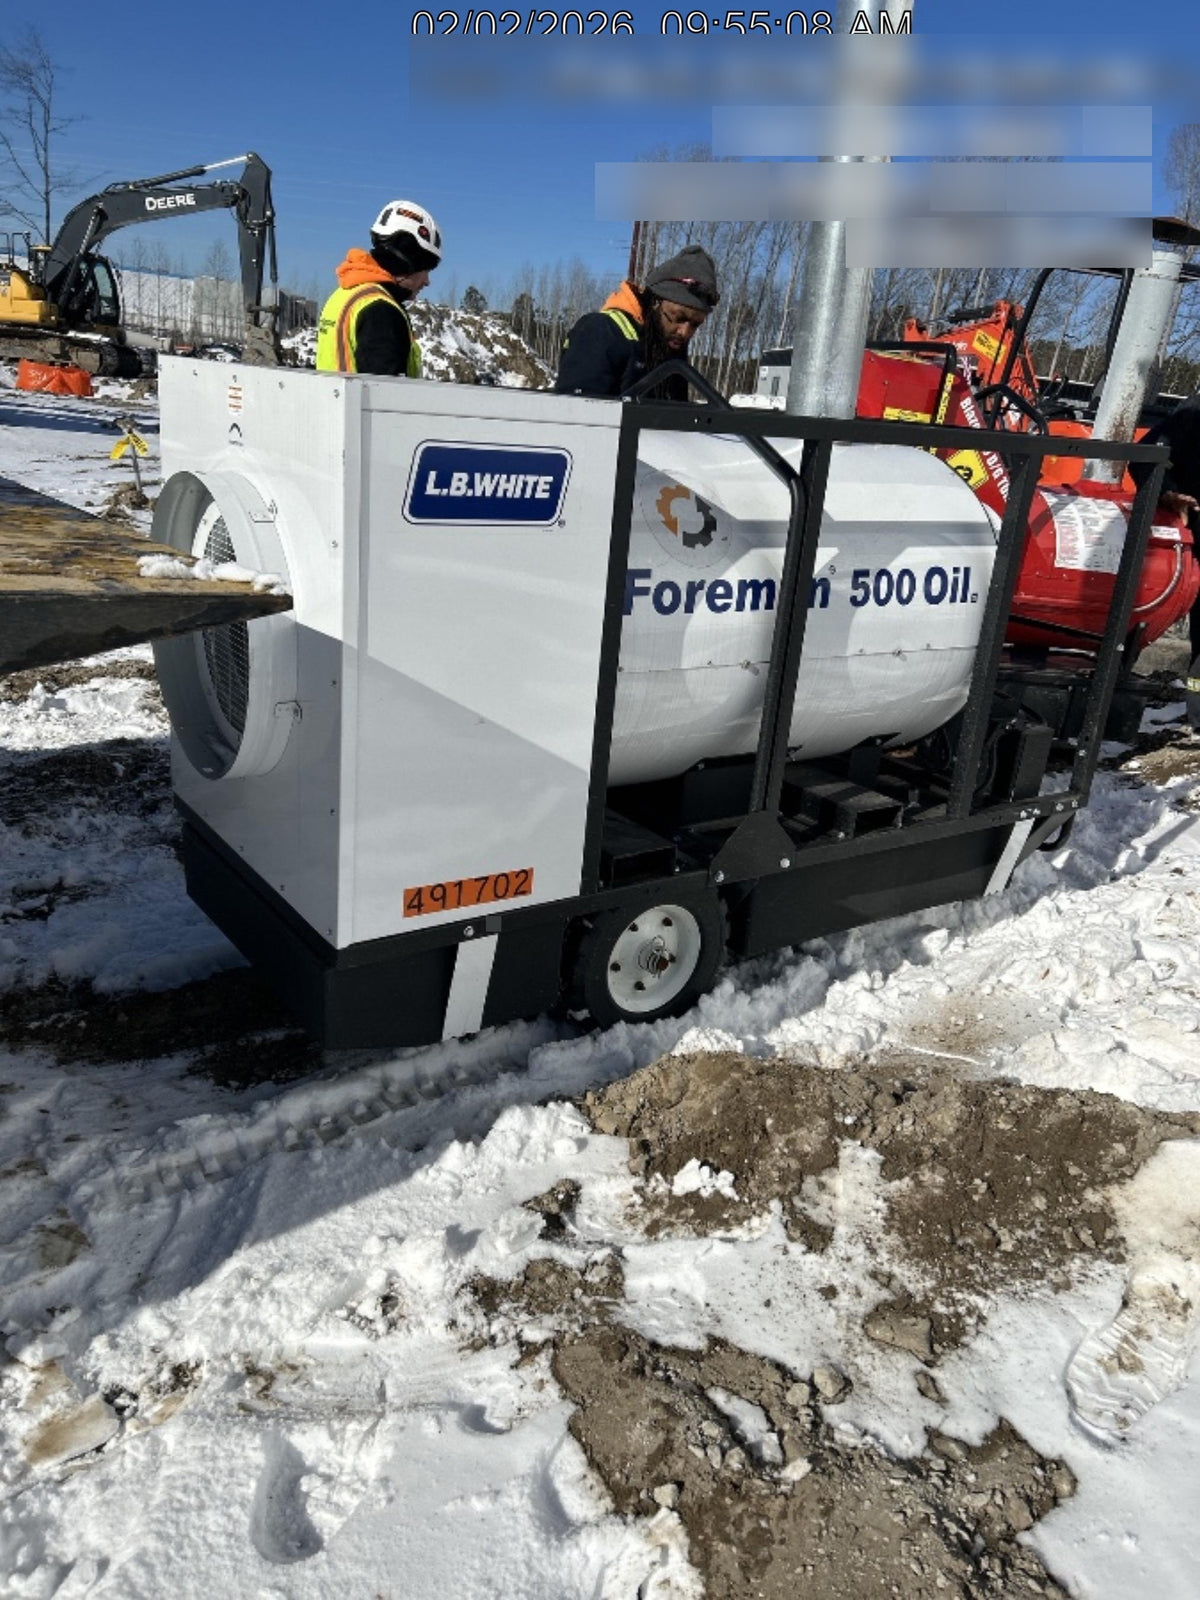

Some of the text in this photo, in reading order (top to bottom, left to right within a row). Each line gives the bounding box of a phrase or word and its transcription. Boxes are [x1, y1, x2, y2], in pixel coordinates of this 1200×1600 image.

[145, 193, 196, 211] DEERE
[622, 568, 831, 616] Foremn
[849, 568, 917, 608] 500
[406, 869, 529, 913] 491702
